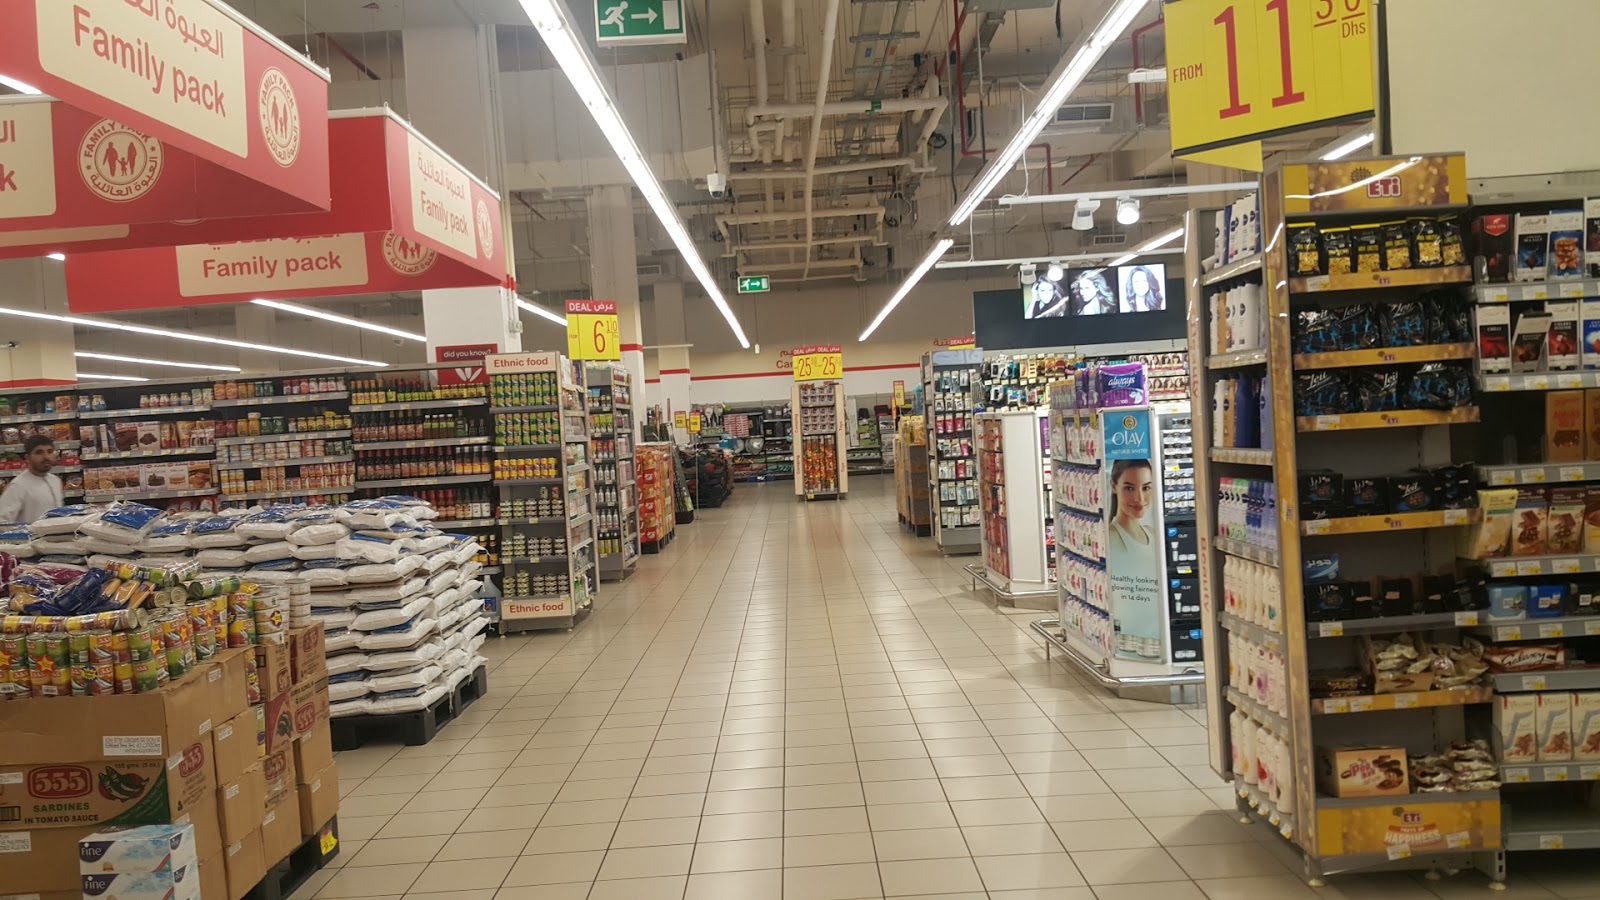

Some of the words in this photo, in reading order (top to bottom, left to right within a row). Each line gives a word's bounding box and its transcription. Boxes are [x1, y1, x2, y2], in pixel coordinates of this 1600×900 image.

[1342, 21, 1366, 38] Dhs
[73, 4, 165, 95] Family
[173, 66, 226, 118] pack
[1214, 0, 1305, 119] 11
[1173, 62, 1203, 83] FROM
[261, 73, 278, 105] FAMILY
[279, 76, 295, 108] PACK
[84, 121, 116, 158] FAMILY
[1368, 177, 1401, 196] ETi
[420, 190, 449, 231] Family
[449, 211, 469, 237] pack
[202, 255, 277, 279] Family
[285, 250, 342, 277] pack
[569, 302, 591, 311] DEAL
[594, 302, 614, 311] عرض
[593, 320, 606, 353] 6
[456, 351, 469, 359] you
[469, 349, 492, 357] know?
[494, 359, 525, 368] Ethnic
[527, 357, 548, 367] food
[798, 357, 812, 377] 25
[822, 356, 836, 376] 25
[1107, 376, 1136, 387] always
[1110, 574, 1134, 584] Healthy
[1135, 576, 1159, 586] looking
[1200, 537, 1210, 614] Beauty
[1111, 584, 1135, 593] glowing
[1135, 585, 1159, 593] fairness
[1135, 594, 1151, 603] days
[509, 603, 540, 613] Ethnic
[542, 602, 564, 612] food
[1501, 651, 1546, 668] Galaxy
[35, 771, 86, 793] 555
[33, 802, 90, 813] SARDINES
[24, 817, 33, 825] IN
[36, 815, 70, 824] TOMATO
[71, 814, 99, 822] SAUCE
[1403, 813, 1421, 823] ETi
[1384, 829, 1442, 845] HAPPINESS
